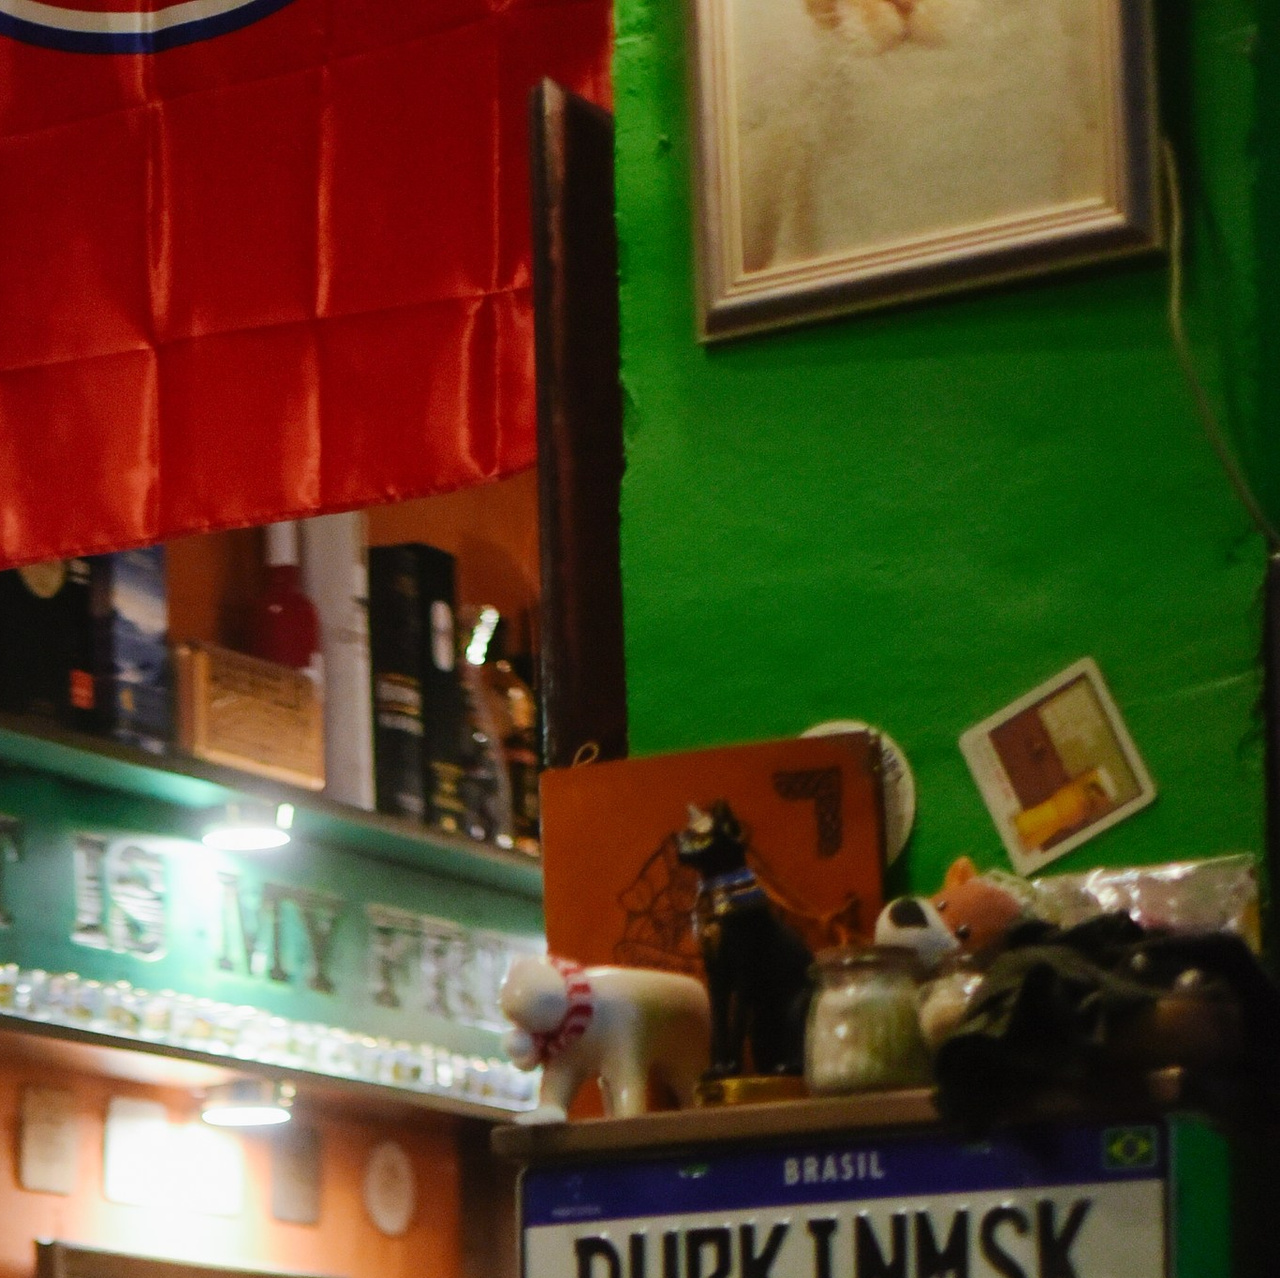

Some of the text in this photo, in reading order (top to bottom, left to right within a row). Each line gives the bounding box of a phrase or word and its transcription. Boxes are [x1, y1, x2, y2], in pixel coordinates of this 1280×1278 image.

[71, 832, 168, 962] IS
[215, 870, 348, 994] MY
[783, 1151, 887, 1186] BRASIL
